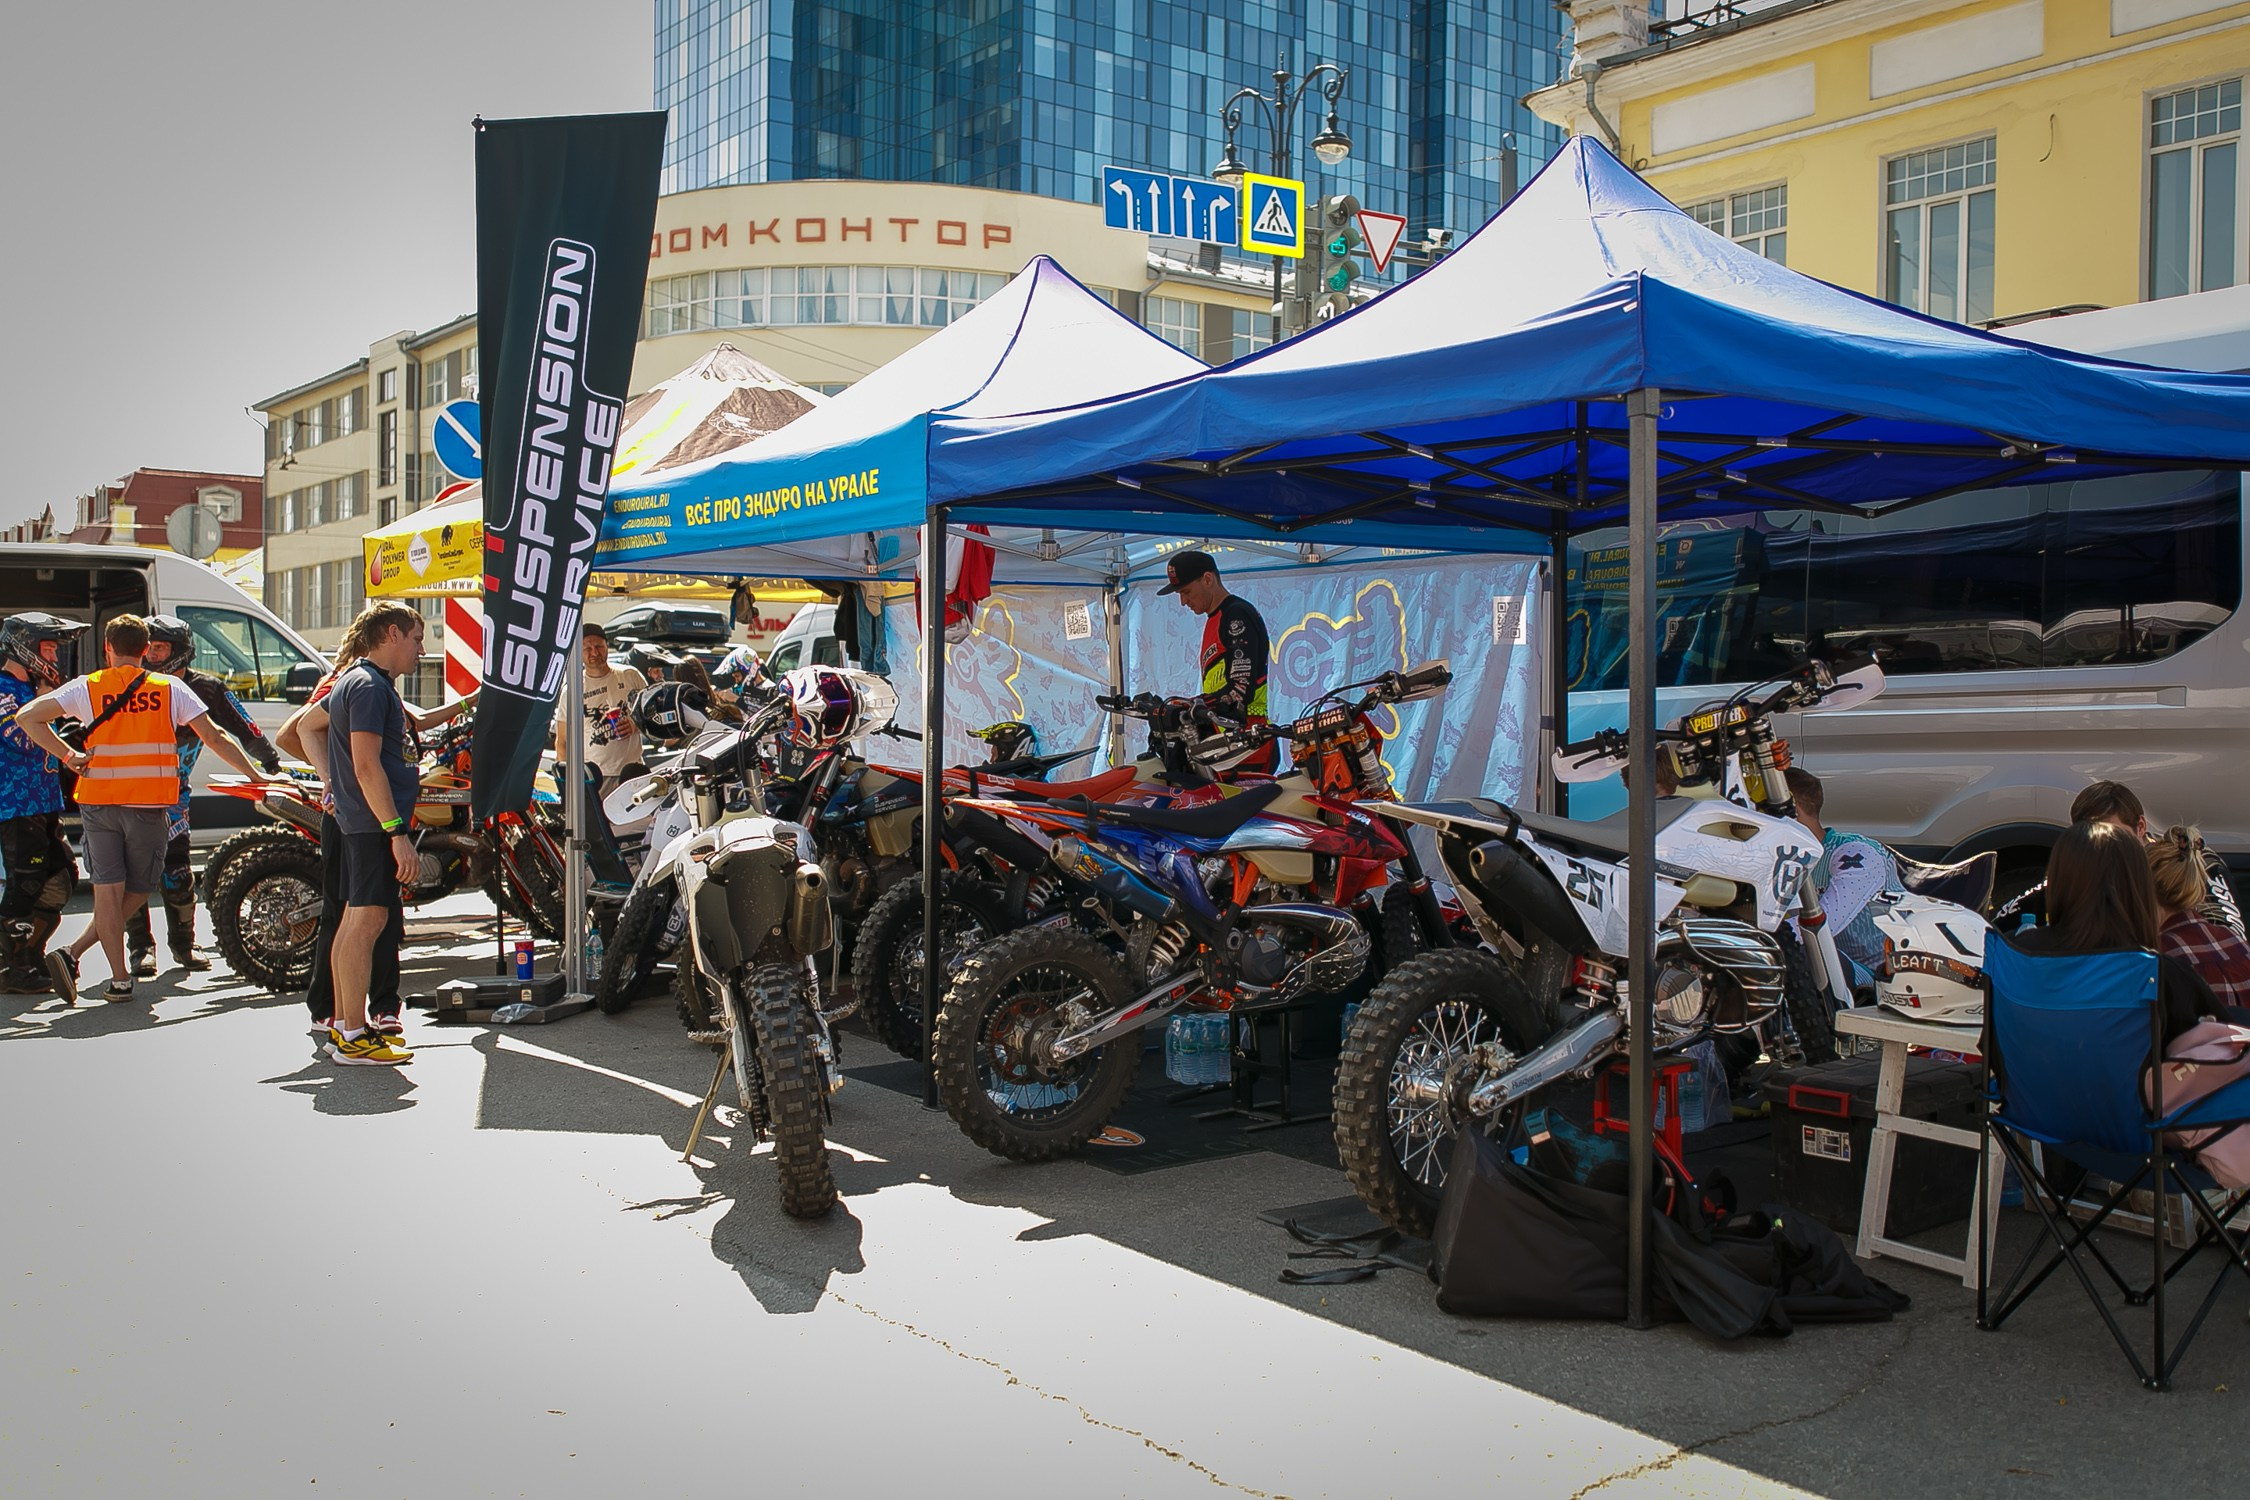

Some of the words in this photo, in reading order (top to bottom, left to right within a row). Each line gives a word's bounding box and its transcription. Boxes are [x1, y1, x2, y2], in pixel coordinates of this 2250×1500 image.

[749, 217, 1012, 249] КОНТОР
[500, 246, 588, 692] SUSPENSION
[614, 493, 671, 514] ENDUROURAL.RU
[685, 496, 711, 527] ВСЁ
[713, 496, 741, 523] ПРО
[744, 484, 801, 519] ЭНДУРО
[804, 481, 828, 508] НА
[828, 468, 880, 503] УРАЛЕ
[382, 540, 395, 553] URAL
[539, 399, 619, 696] SERVICE
[382, 550, 405, 566] POLYMER
[383, 566, 400, 580] GROUP
[1693, 706, 1742, 730] PROTER
[875, 795, 907, 808] SUSPENSION
[875, 804, 897, 813] SERVICE
[1136, 843, 1176, 880] 54
[1892, 955, 1944, 972] LEATT
[1882, 993, 1921, 1009] JUST1
